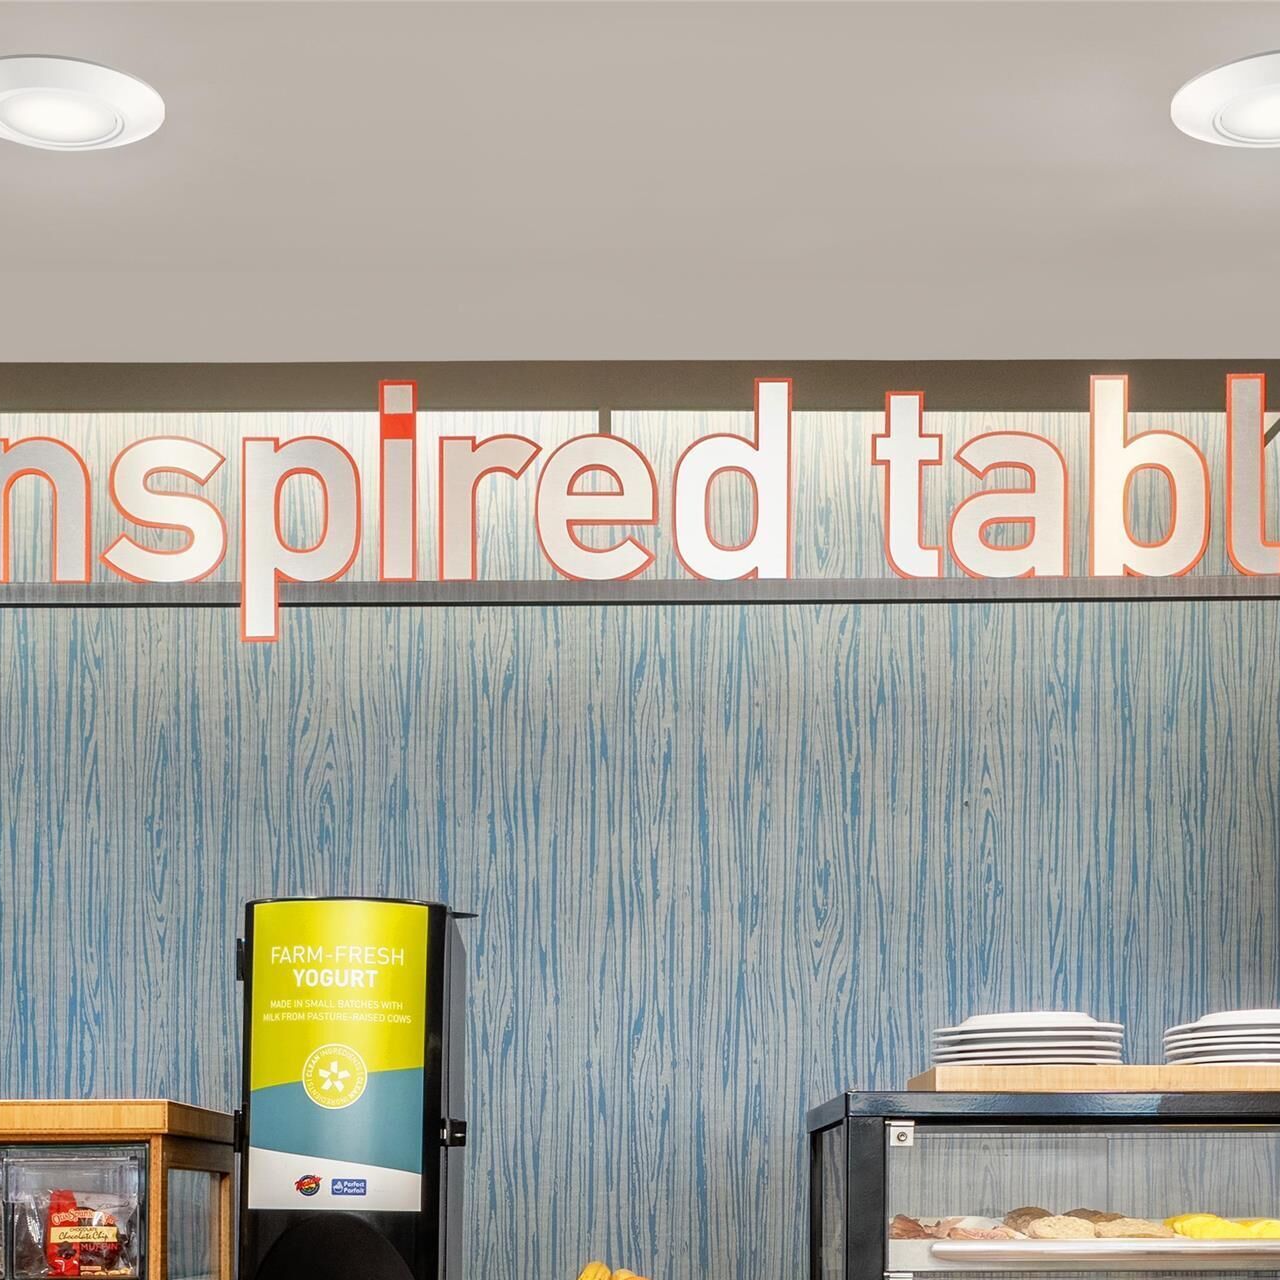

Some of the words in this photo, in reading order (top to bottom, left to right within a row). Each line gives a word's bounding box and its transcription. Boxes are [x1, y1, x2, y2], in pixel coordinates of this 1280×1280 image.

[271, 945, 405, 966] FARM-FRESH
[293, 969, 379, 988] YOGURT
[270, 1000, 292, 1009] MADE
[294, 1000, 303, 1008] IN
[305, 1000, 335, 1009] SMALL
[337, 1000, 379, 1009] BATCHES
[381, 1001, 403, 1010] WITH
[263, 1013, 280, 1022] MILK
[281, 1012, 305, 1021] FROM
[307, 1012, 385, 1023] PASTURE-RAISED
[387, 1014, 412, 1024] COWS
[58, 1231, 92, 1240] Chocolate
[92, 1230, 109, 1242] Chip
